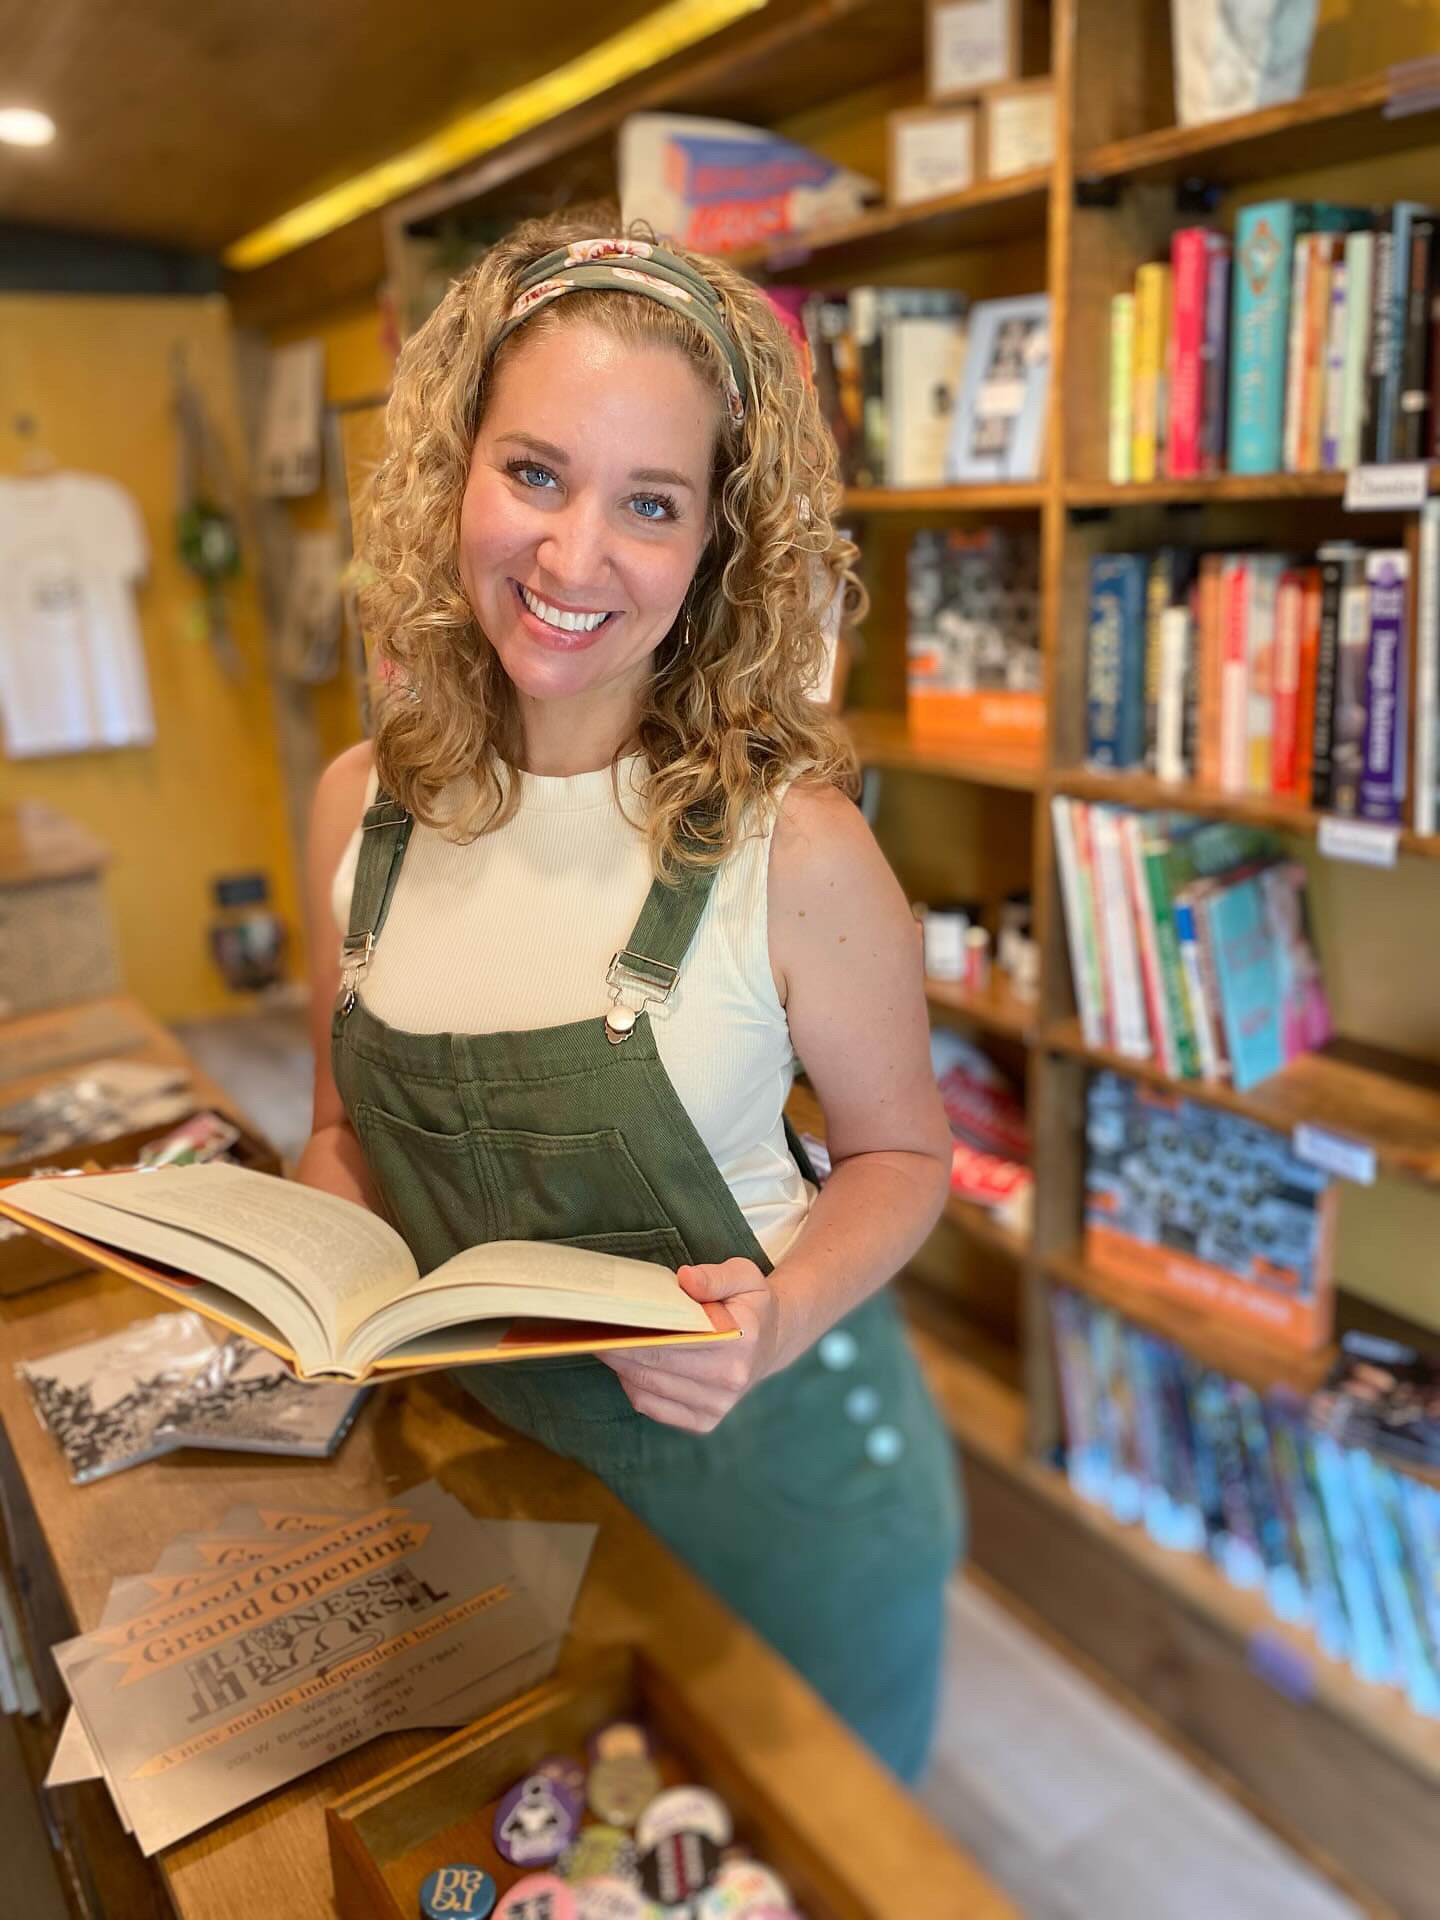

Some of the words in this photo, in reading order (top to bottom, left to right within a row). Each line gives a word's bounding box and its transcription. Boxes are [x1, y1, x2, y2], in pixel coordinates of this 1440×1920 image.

[141, 1599, 263, 1665] Grand
[267, 1529, 417, 1607] Opening
[210, 1570, 391, 1668] LINESS
[245, 1590, 405, 1680] BKS
[179, 1732, 220, 1758] new
[226, 1693, 295, 1735] mobile
[297, 1634, 409, 1699] independent
[297, 1716, 359, 1750] Saturday
[338, 1728, 362, 1746] AM
[383, 1704, 408, 1722] PM
